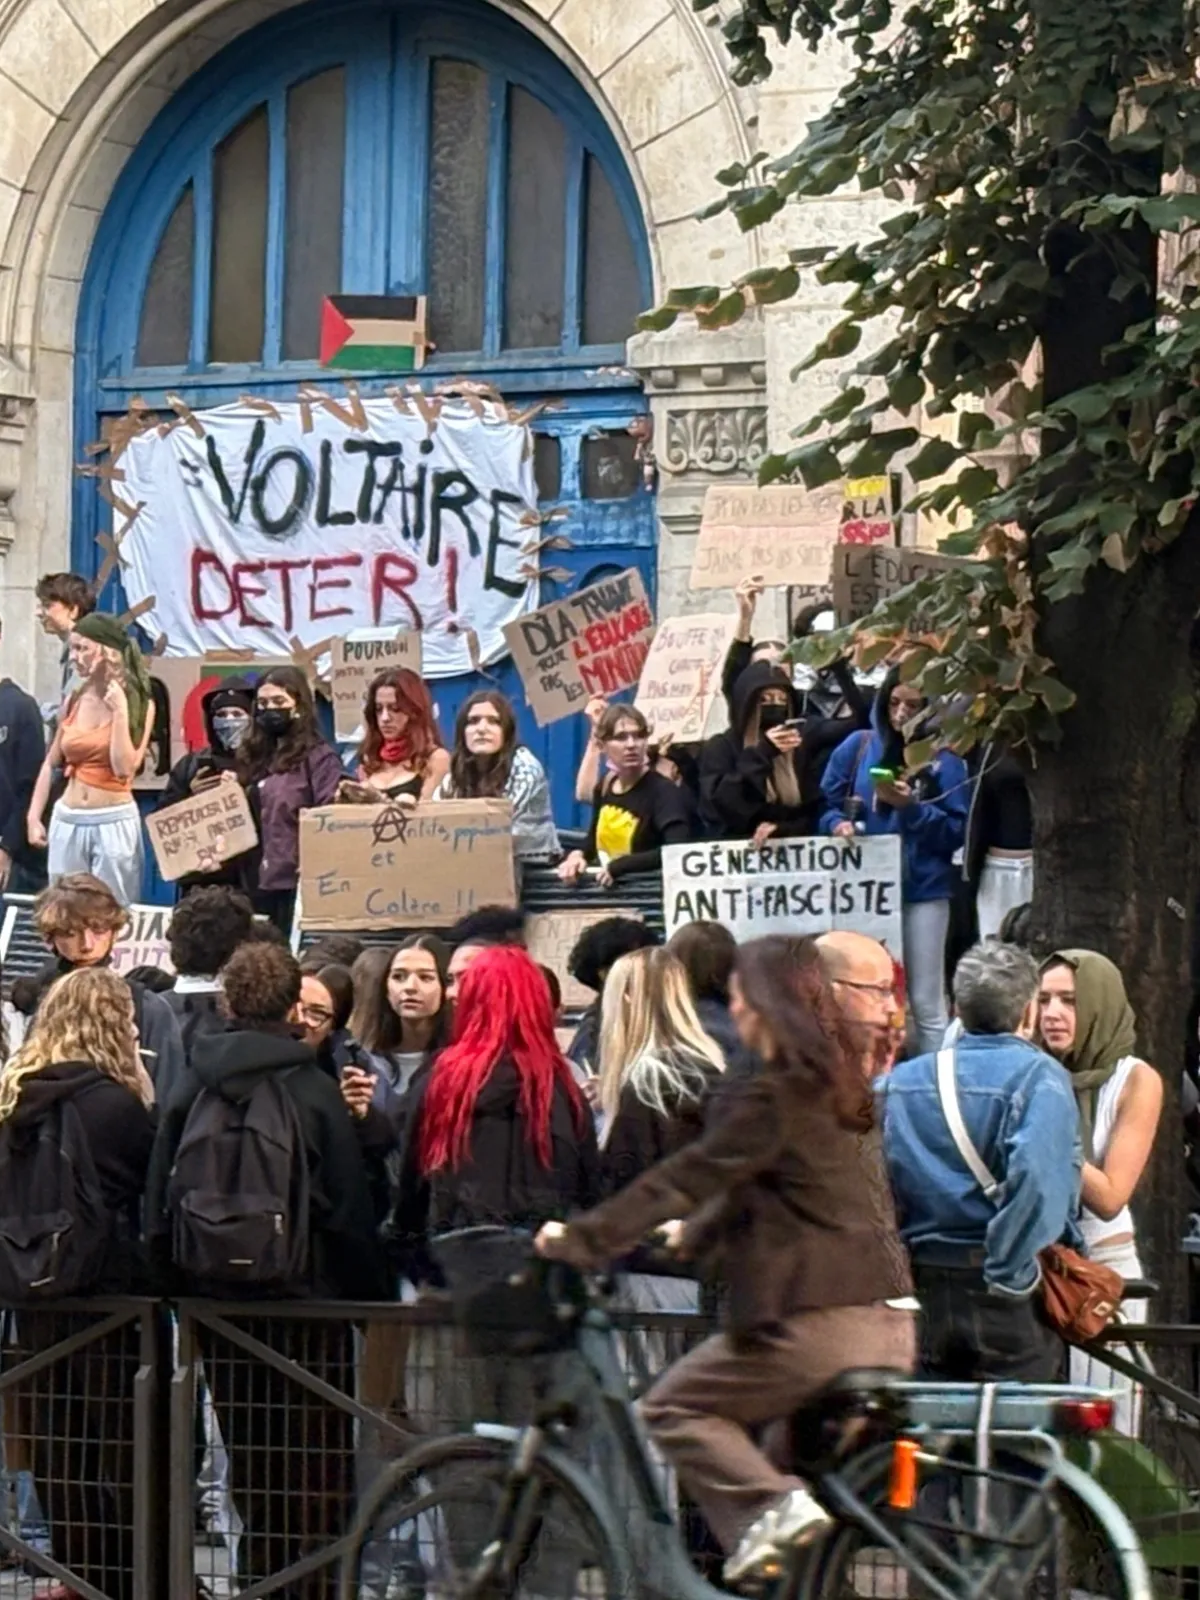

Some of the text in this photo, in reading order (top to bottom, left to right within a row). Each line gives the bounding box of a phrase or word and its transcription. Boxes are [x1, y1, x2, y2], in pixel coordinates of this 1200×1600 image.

[862, 498, 886, 518] LA
[343, 639, 408, 662] POURQUOI
[222, 793, 240, 813] LE
[371, 851, 396, 867] et
[317, 870, 351, 897] En
